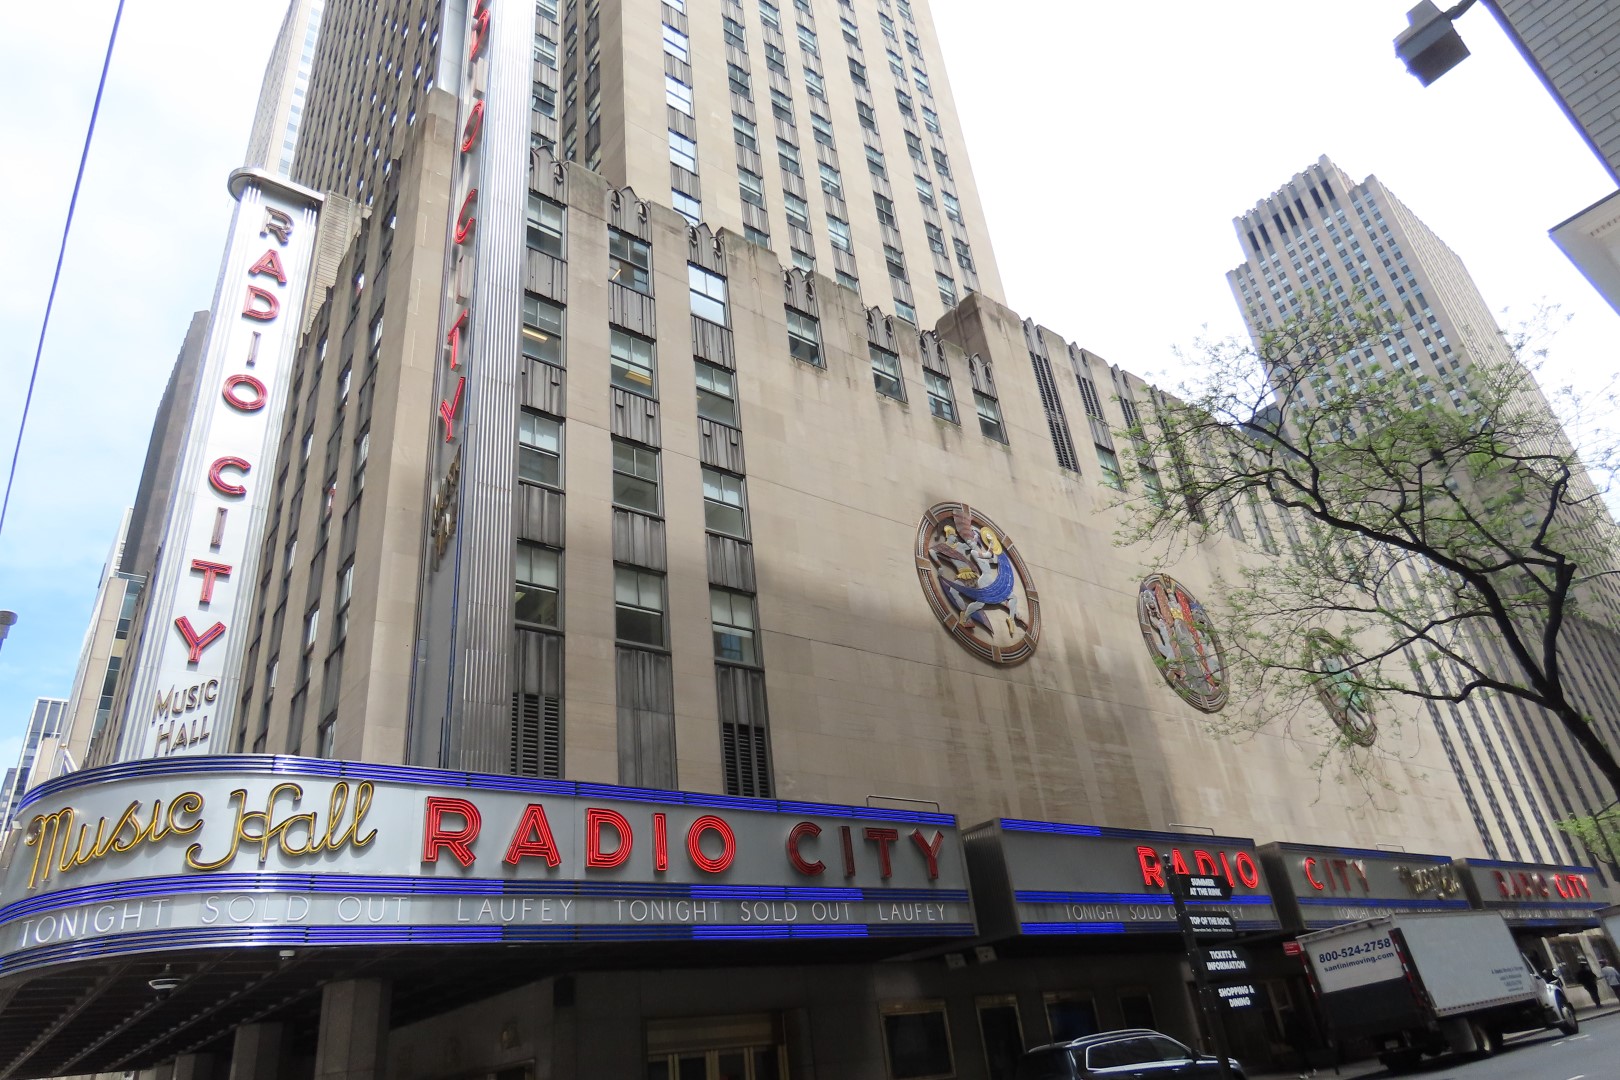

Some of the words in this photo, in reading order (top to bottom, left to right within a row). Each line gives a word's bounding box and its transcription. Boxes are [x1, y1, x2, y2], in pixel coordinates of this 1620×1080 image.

[222, 206, 295, 410] RADIO
[174, 455, 251, 664] CITY
[152, 680, 218, 724] MUSIC
[154, 715, 209, 757] HALL
[26, 791, 203, 889] Music
[185, 780, 378, 870] Hall
[422, 796, 736, 874] RADIO
[786, 821, 944, 880] CITY
[1137, 846, 1258, 888] RADIO
[1304, 857, 1369, 892] CITY
[1190, 887, 1197, 896] AT
[1197, 888, 1208, 896] THE
[20, 899, 169, 947] TONIGHT
[202, 895, 308, 923] SOLD
[338, 896, 407, 922] OUT
[457, 897, 574, 922] LAUFEY
[614, 900, 720, 921] TONIGHT
[740, 901, 798, 921] SOLD
[811, 902, 851, 921] OUT
[878, 902, 946, 921] LAUFEY
[1065, 905, 1120, 920] TONIGHT
[1130, 905, 1161, 920] SOLD
[1189, 916, 1200, 925] TOP
[1200, 917, 1208, 925] OF
[1207, 917, 1217, 925] THE
[1217, 917, 1231, 925] ROCK
[1206, 960, 1246, 971] INFORMATION
[1209, 951, 1231, 959] TICKETS
[1319, 938, 1391, 963] 800-524-2758
[1324, 952, 1394, 973] santinimoving.com
[1218, 986, 1249, 997] SHOPPING
[1229, 997, 1251, 1007] DINING
